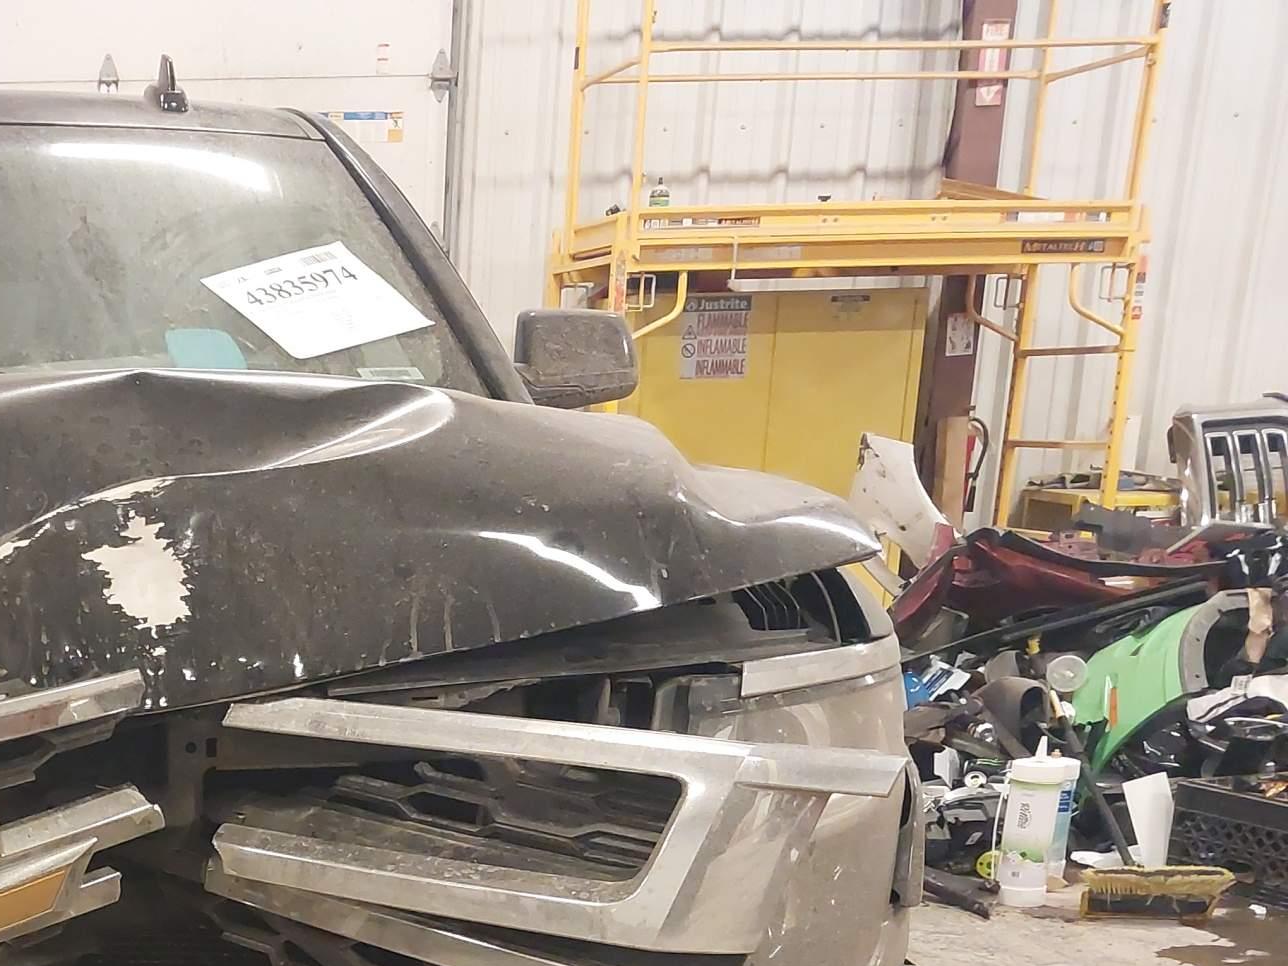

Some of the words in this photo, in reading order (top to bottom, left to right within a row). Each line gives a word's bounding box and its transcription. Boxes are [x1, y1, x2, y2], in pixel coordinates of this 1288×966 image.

[247, 266, 358, 305] 43835974
[698, 298, 749, 310] Justrite
[697, 312, 749, 329] FLAMMABLE
[696, 338, 747, 355] INFLAMABLE
[696, 358, 746, 374] INFLAMMABLE
